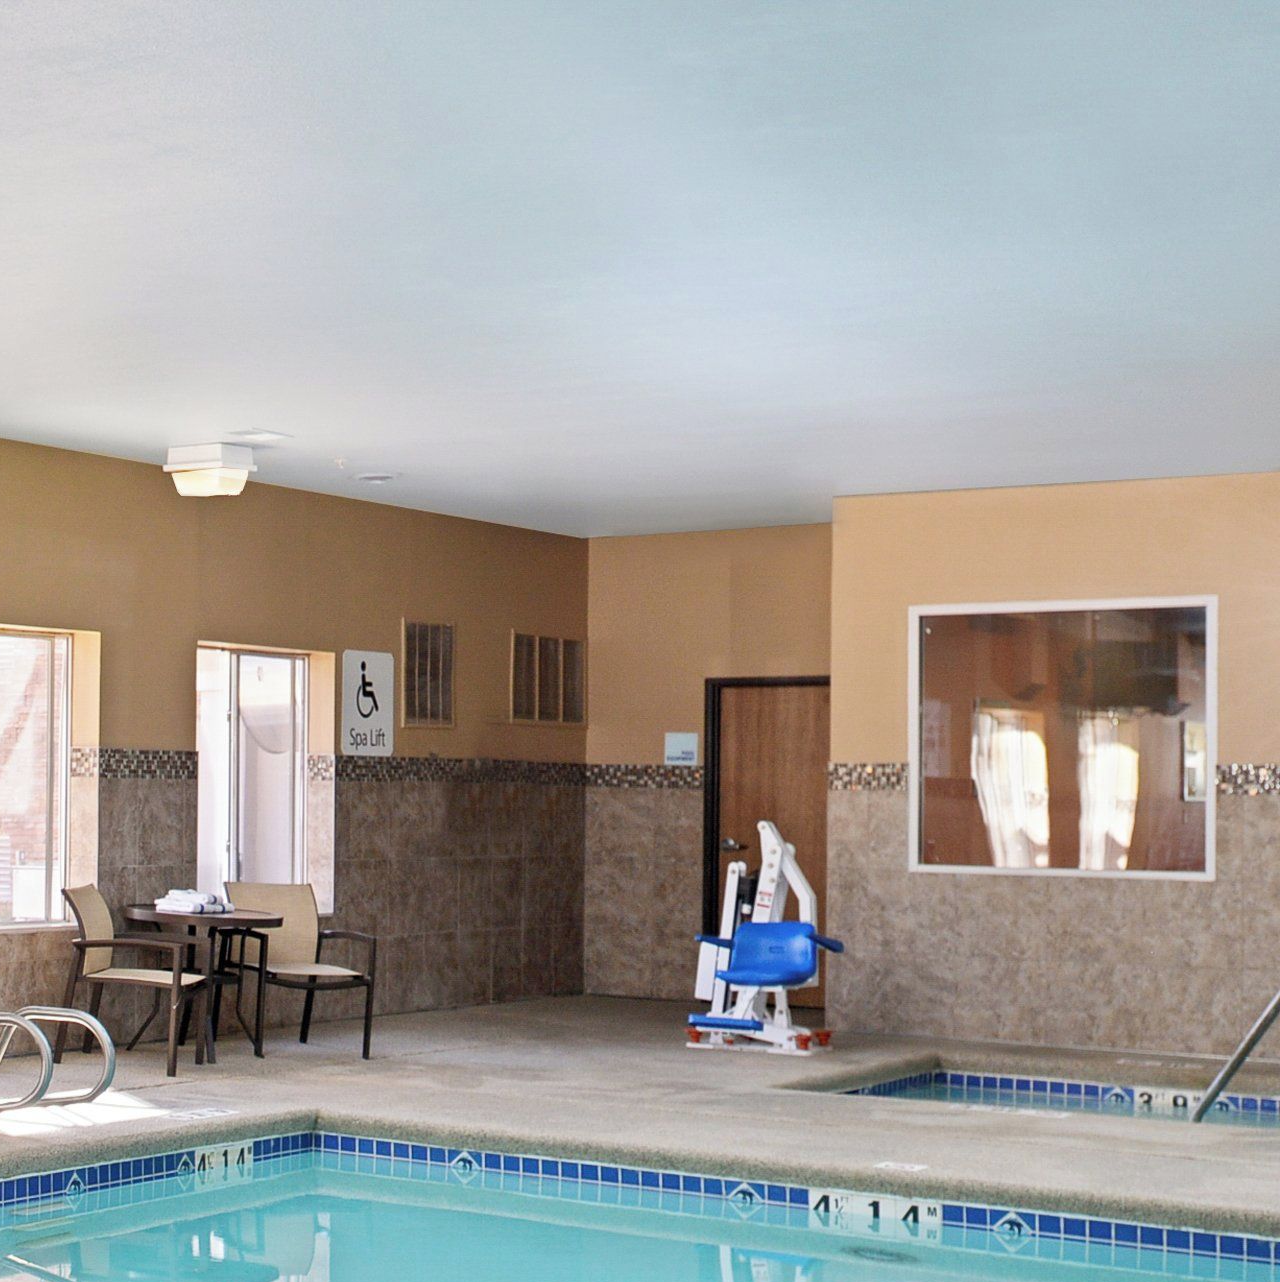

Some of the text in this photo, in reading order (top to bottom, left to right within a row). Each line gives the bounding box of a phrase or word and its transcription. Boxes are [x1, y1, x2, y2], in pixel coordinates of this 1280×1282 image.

[349, 727, 386, 750] Spa Lift
[927, 1206, 937, 1217] M
